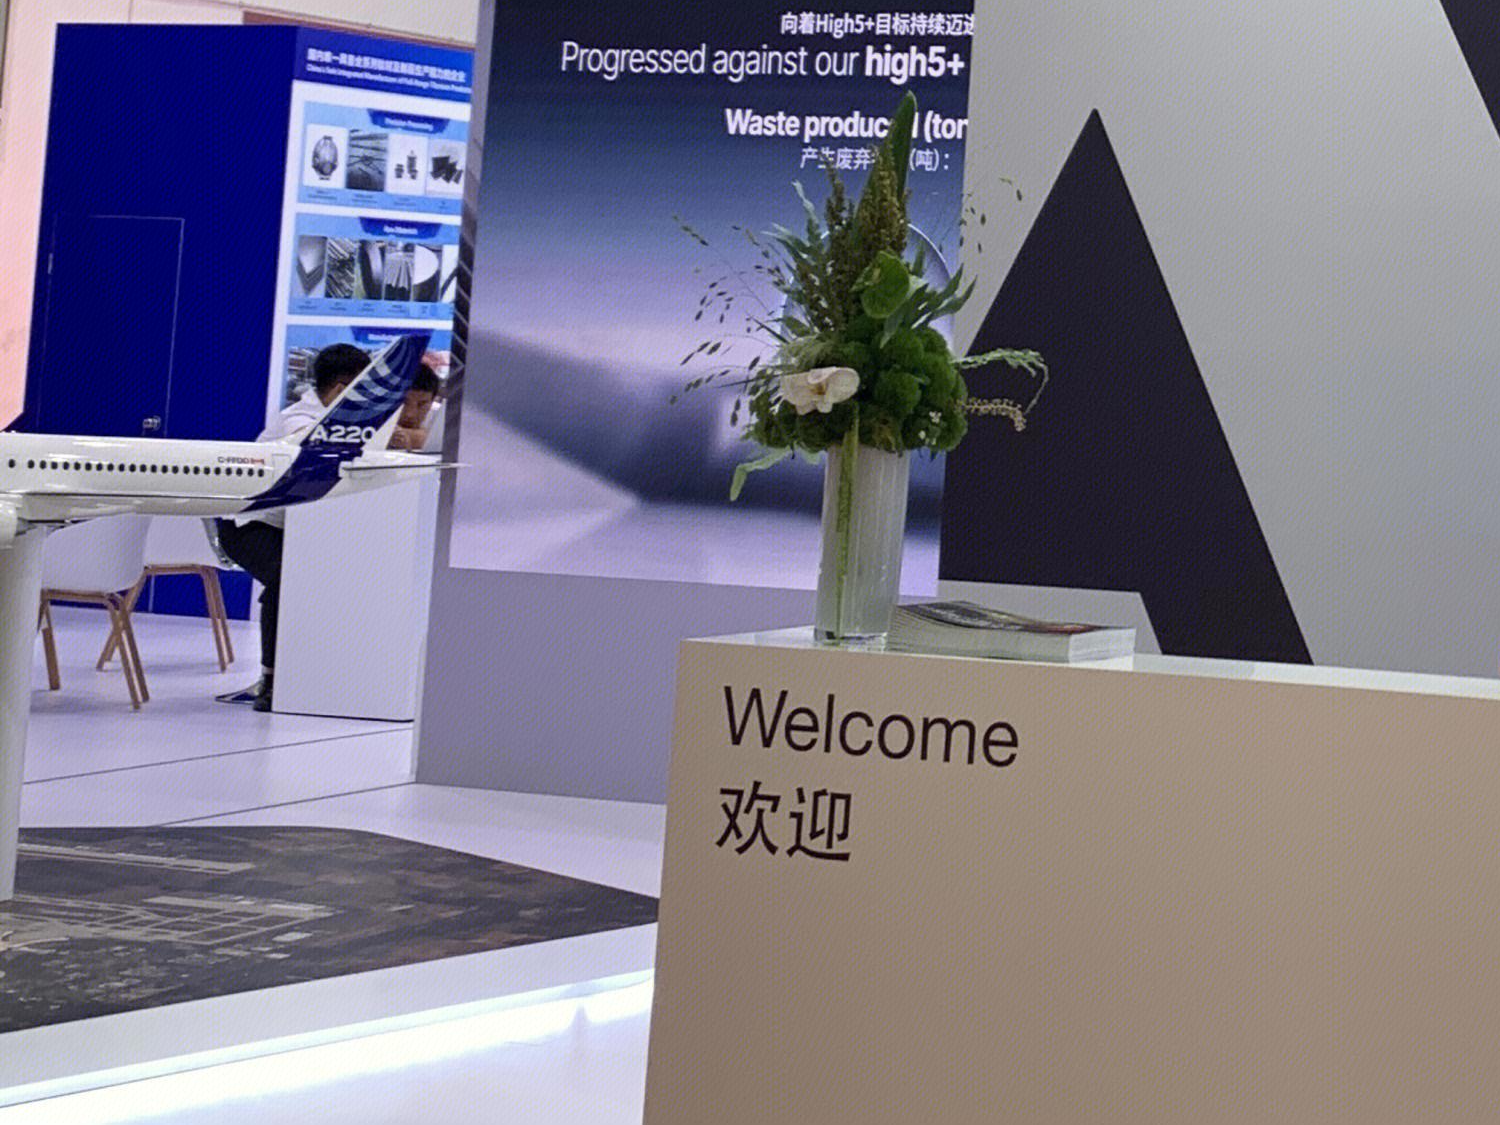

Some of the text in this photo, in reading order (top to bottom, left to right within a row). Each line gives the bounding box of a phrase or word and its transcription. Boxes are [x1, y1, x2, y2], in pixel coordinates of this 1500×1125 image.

[561, 41, 965, 86] Progressed against our high5+
[725, 108, 800, 137] Waste
[803, 110, 919, 144] produc
[311, 425, 376, 444] A220
[723, 685, 1019, 768] Welcome
[714, 780, 852, 862] 欢迎
